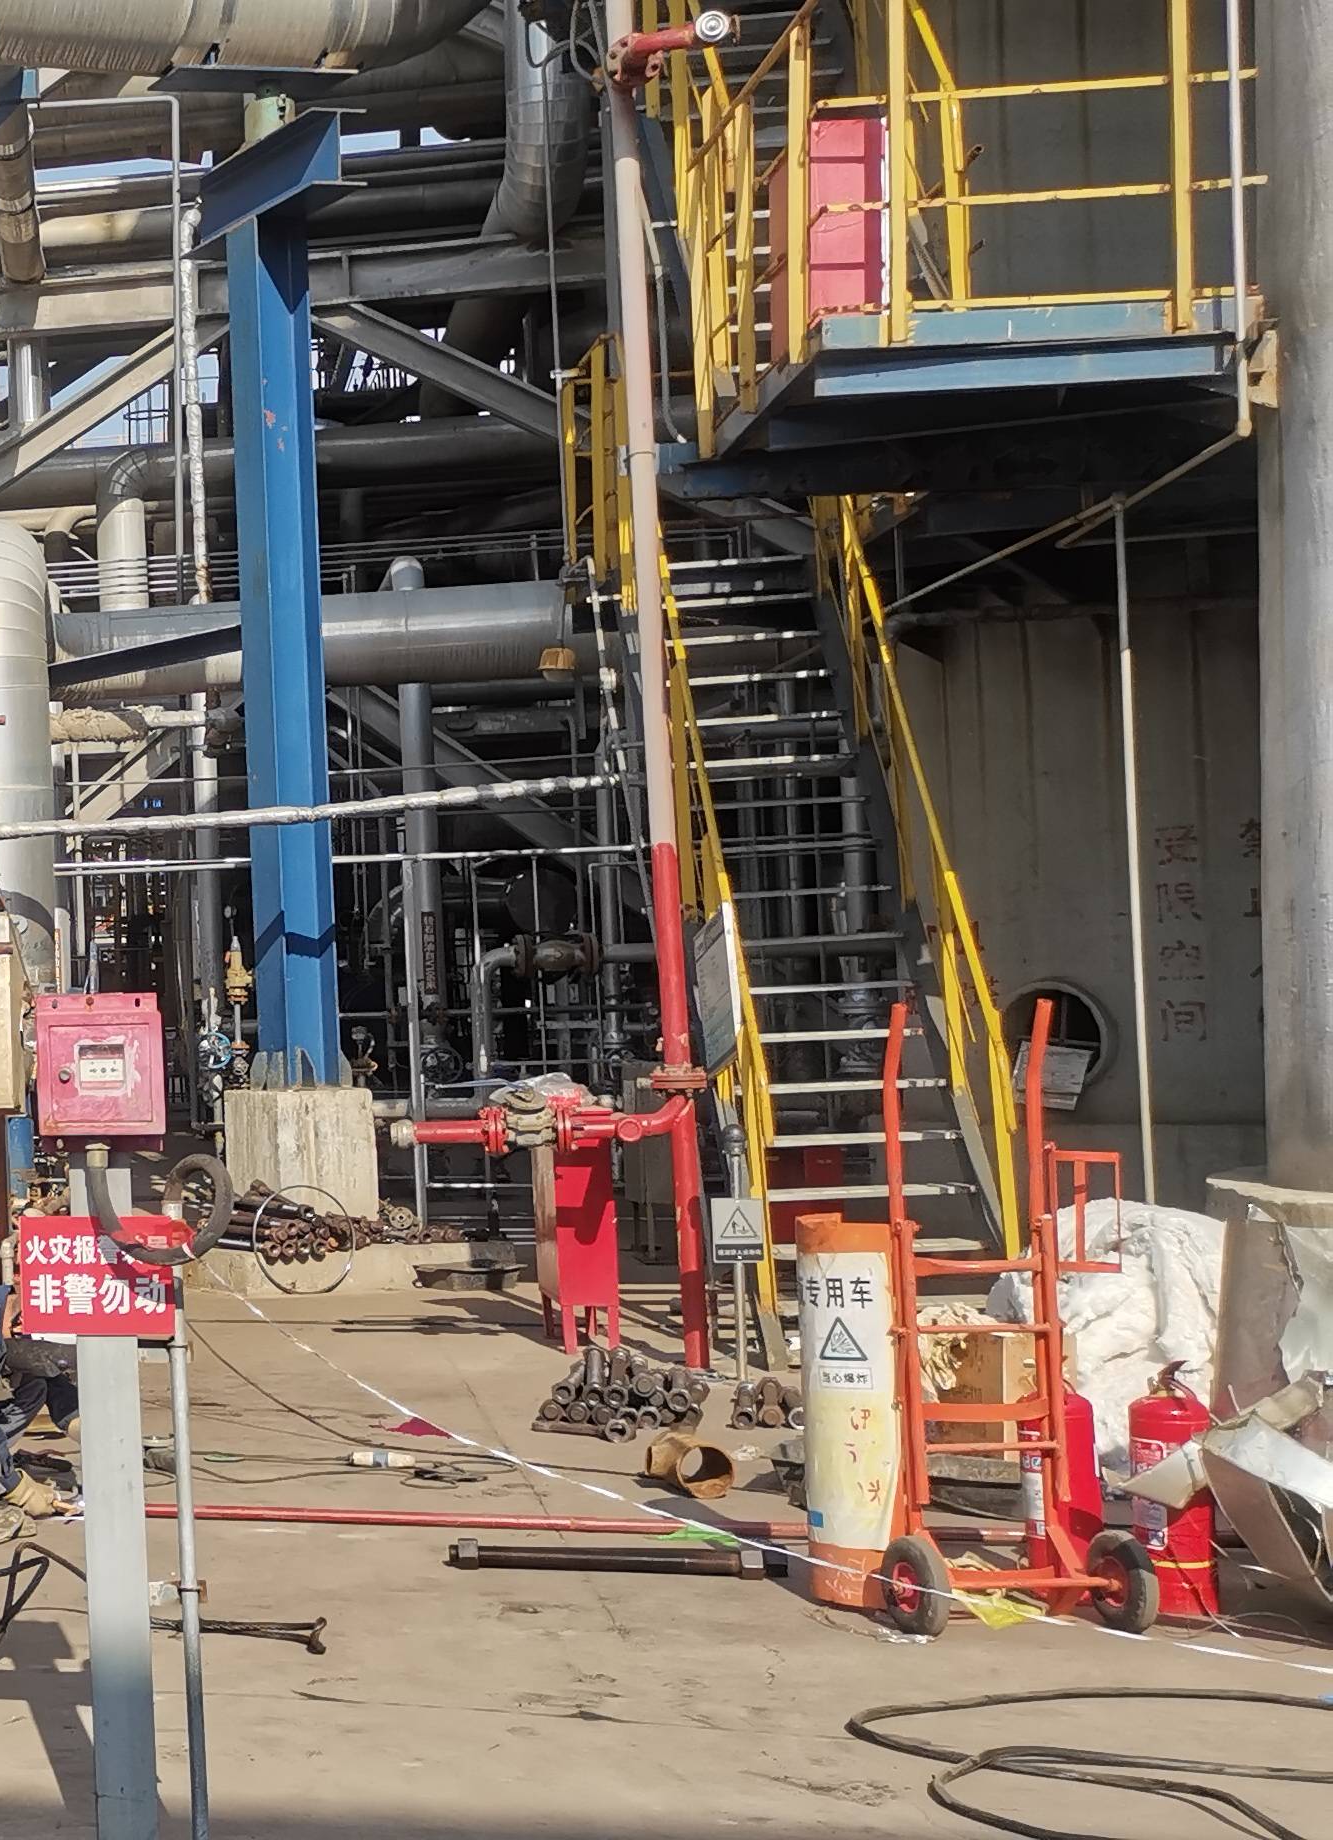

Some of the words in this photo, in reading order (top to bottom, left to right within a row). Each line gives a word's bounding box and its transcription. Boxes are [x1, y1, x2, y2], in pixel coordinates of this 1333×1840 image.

[25, 1235, 166, 1265] 火灾报警
[30, 1274, 167, 1315] 非警勿动
